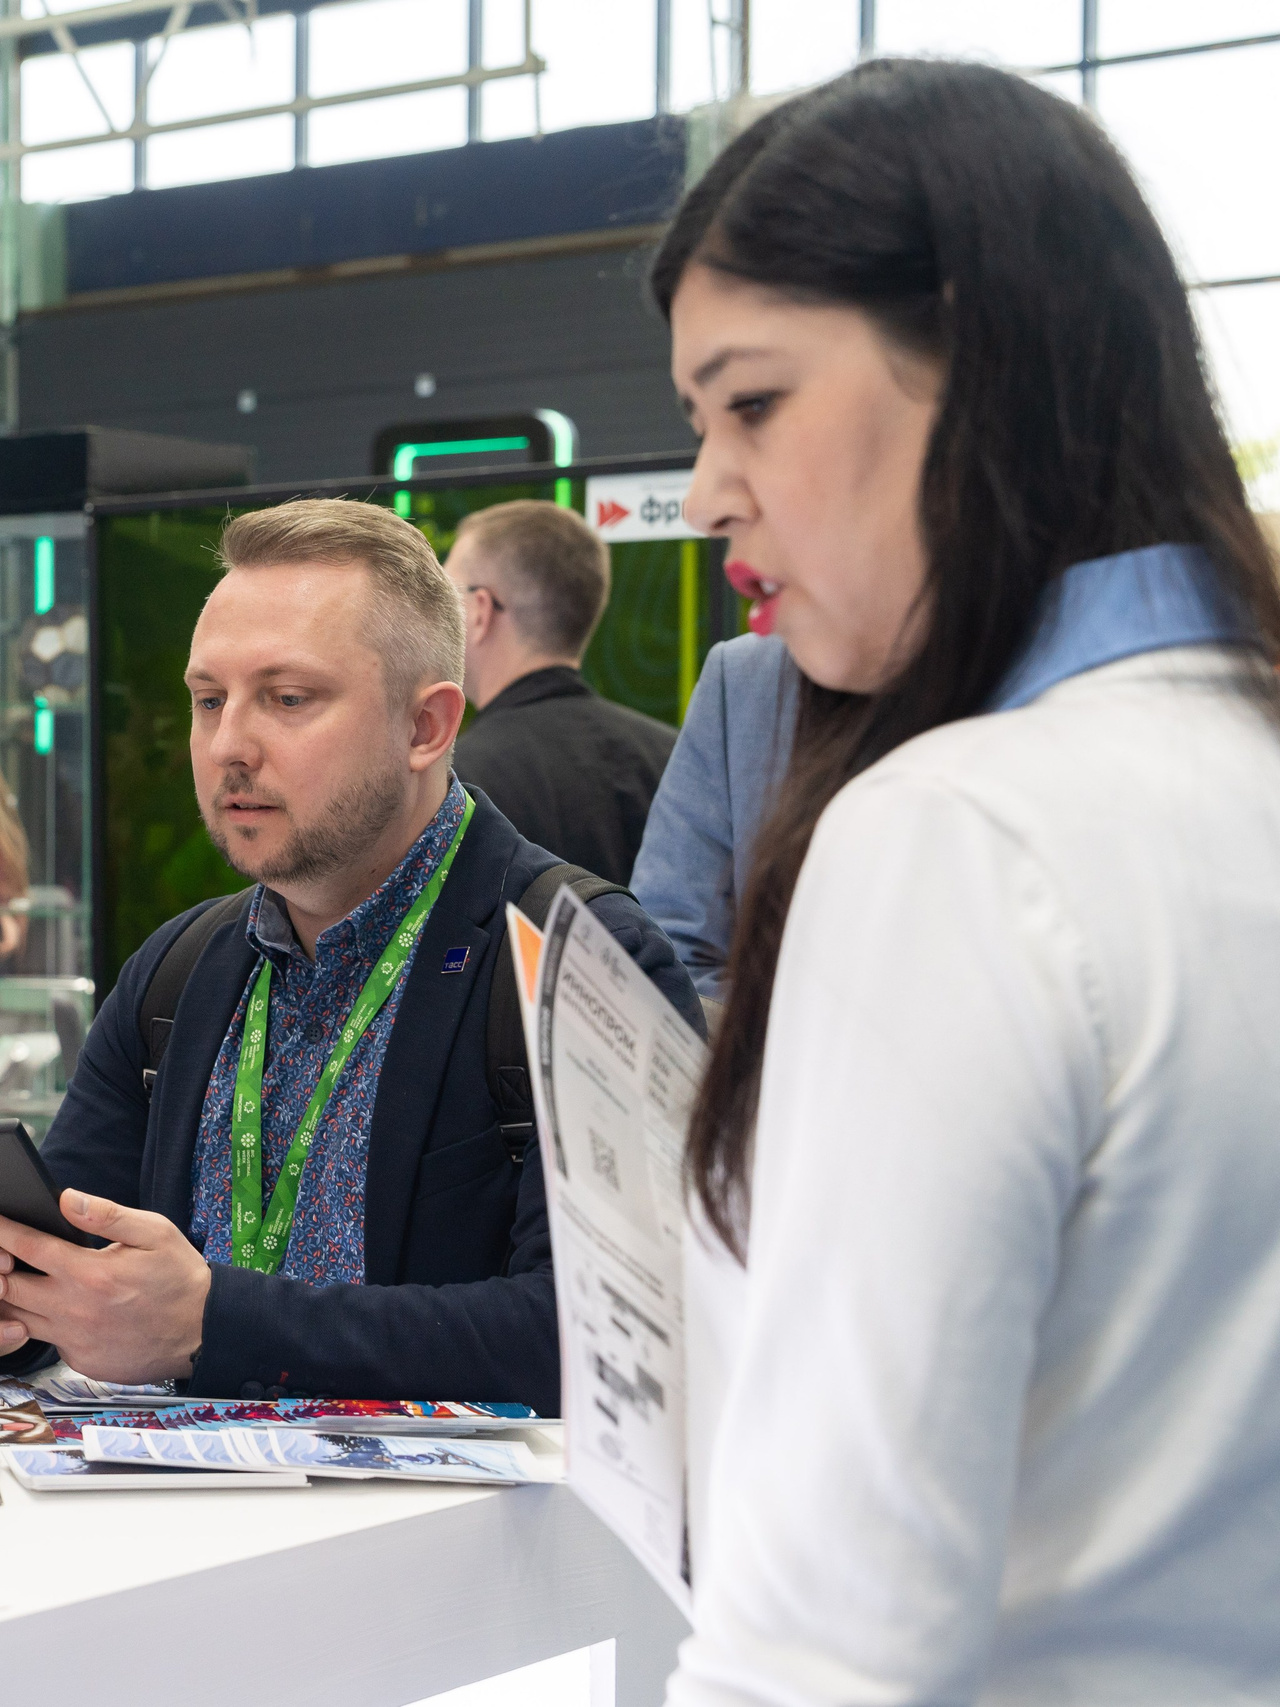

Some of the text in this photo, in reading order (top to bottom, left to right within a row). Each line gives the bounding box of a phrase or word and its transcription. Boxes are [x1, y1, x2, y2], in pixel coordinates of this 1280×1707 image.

[385, 959, 405, 987] INNOPROM
[272, 1207, 284, 1235] INDUSTRIAL
[276, 1222, 284, 1235] WEEK
